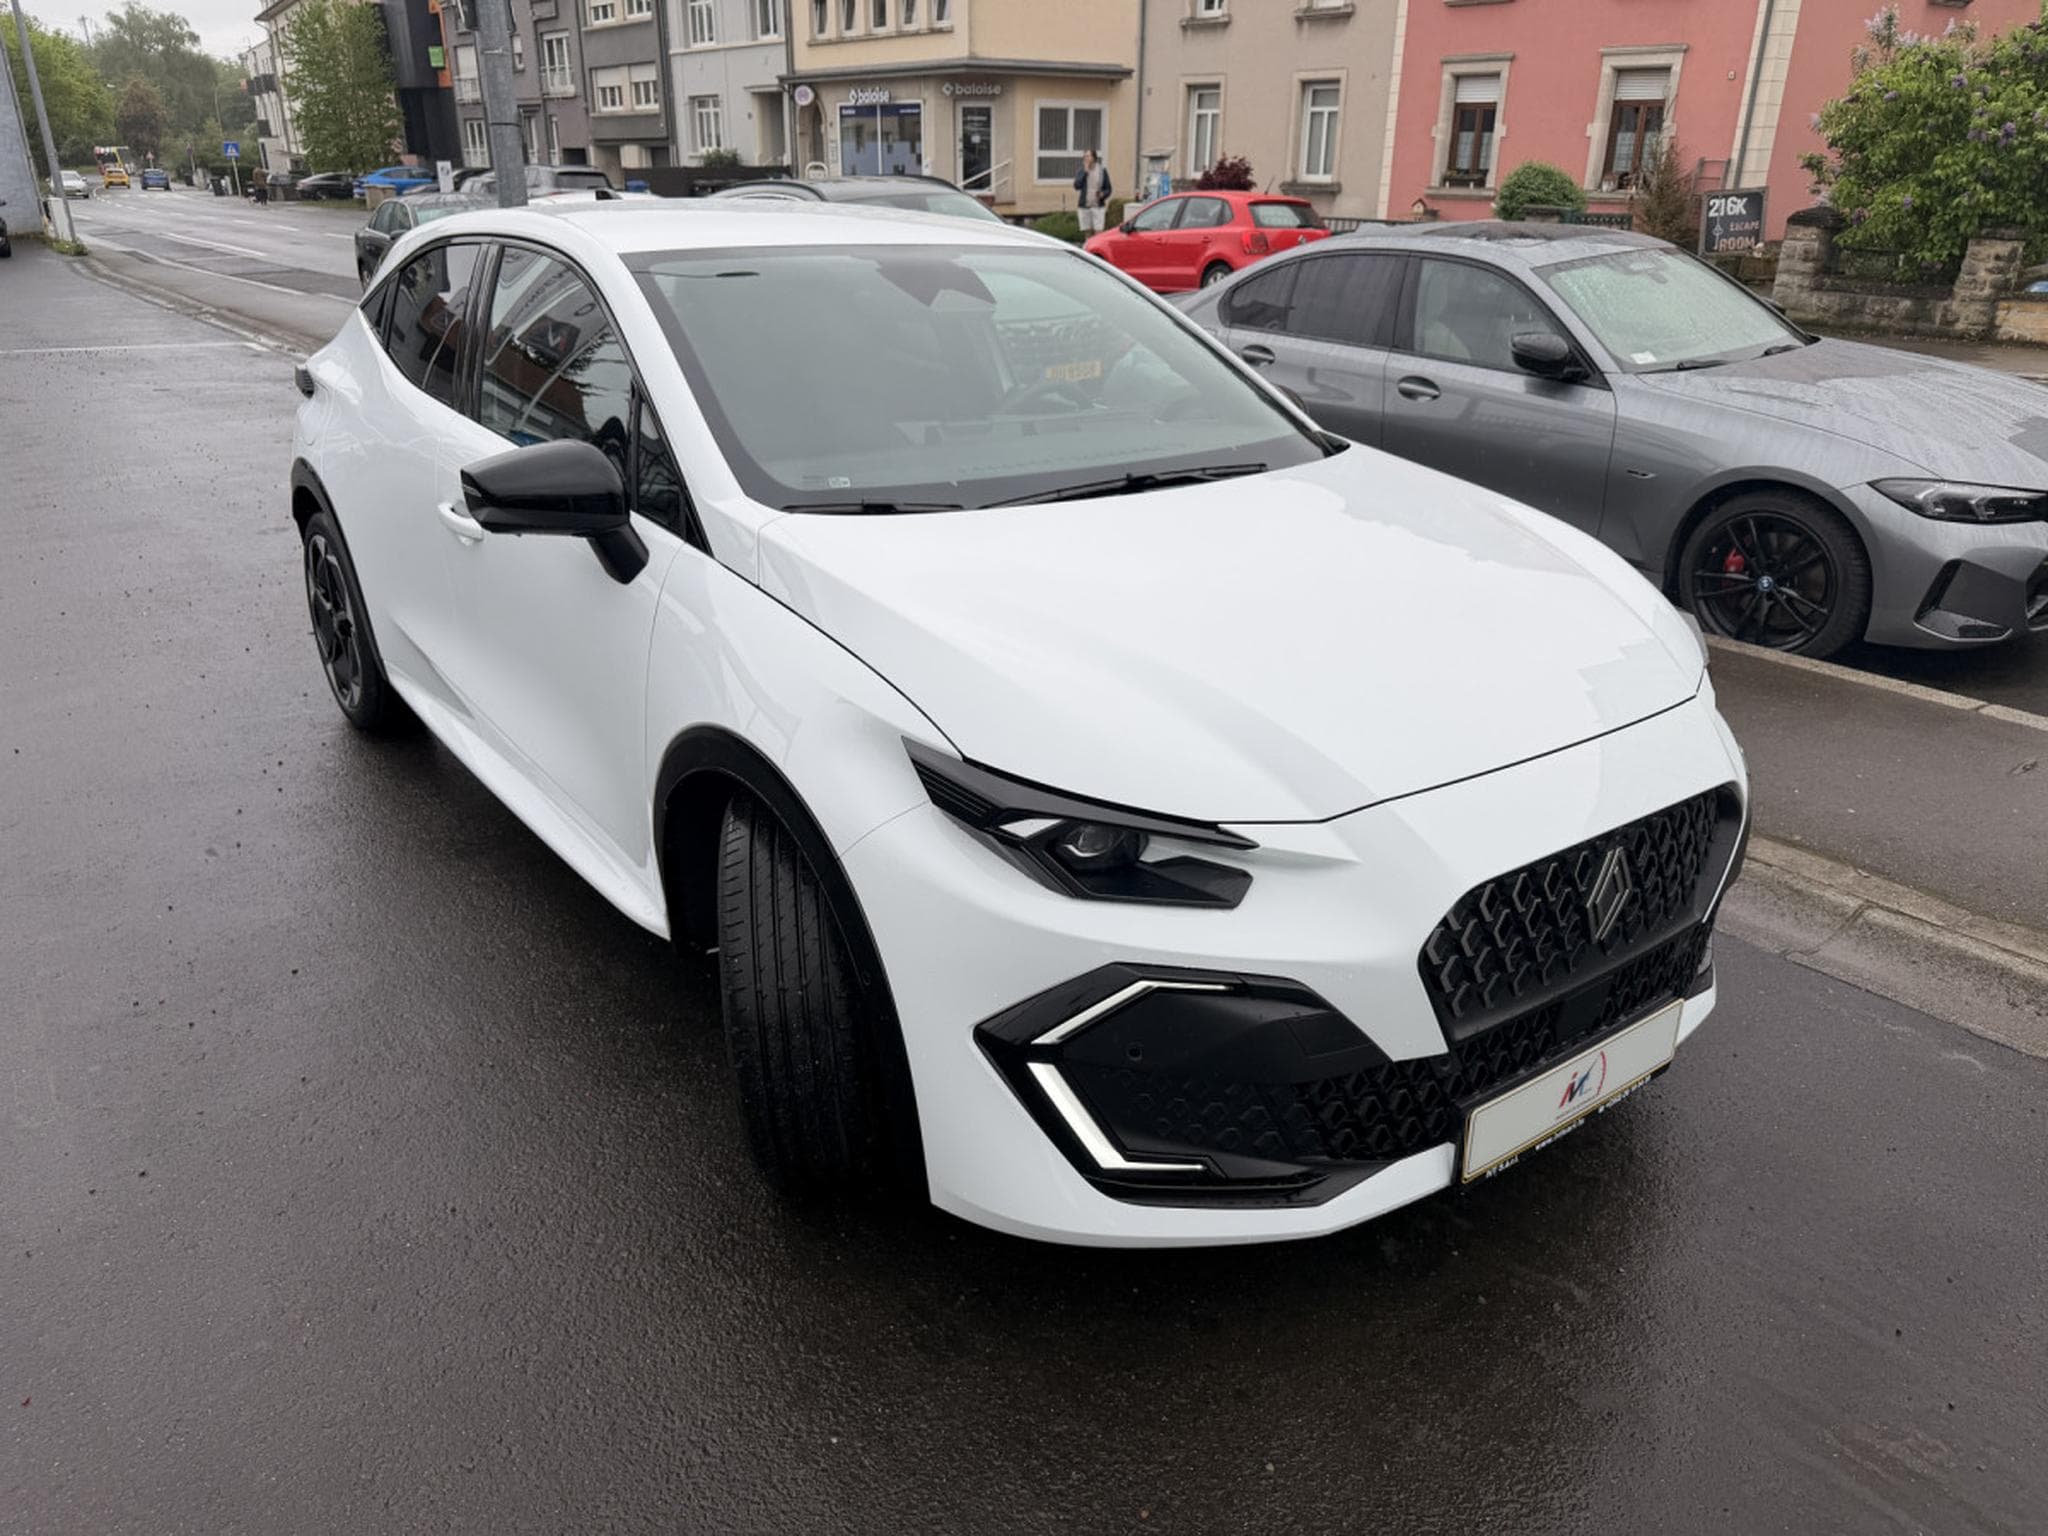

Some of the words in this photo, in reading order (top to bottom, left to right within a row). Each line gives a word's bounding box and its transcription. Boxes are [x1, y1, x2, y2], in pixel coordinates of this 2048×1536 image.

[857, 86, 890, 104] baloise
[955, 82, 1001, 95] baloise
[1708, 196, 1748, 217] 216K
[1719, 236, 1757, 251] ROOM
